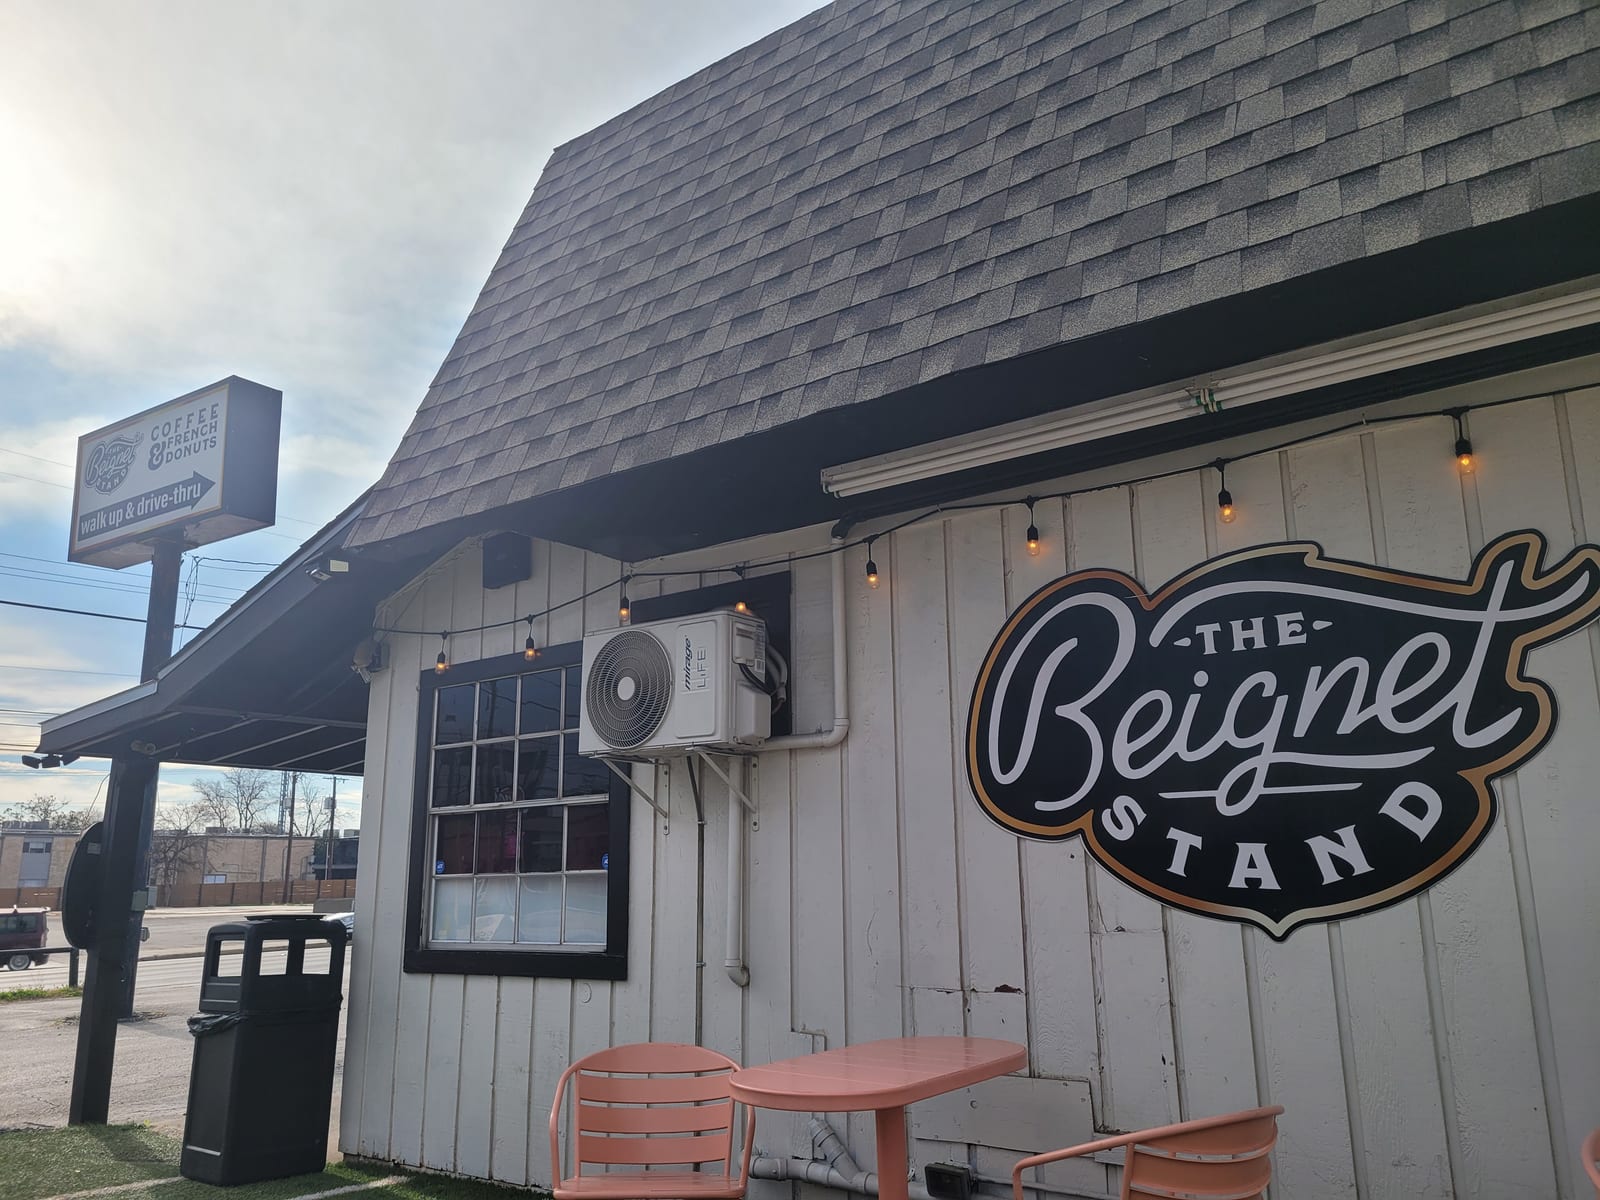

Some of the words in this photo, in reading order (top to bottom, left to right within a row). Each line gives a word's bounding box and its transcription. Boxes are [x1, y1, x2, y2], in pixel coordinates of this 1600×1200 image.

[151, 403, 218, 441] COFFEE
[167, 420, 217, 448] FRENCH
[148, 441, 166, 470] &
[166, 436, 216, 464] DONUTS
[81, 511, 107, 535] walk
[109, 508, 122, 527] up
[125, 502, 135, 519] &
[137, 483, 200, 516] drive-thru
[1196, 611, 1307, 655] THE
[684, 638, 693, 690] mirage
[989, 560, 1590, 816] Beignet
[1102, 782, 1442, 890] STAND
